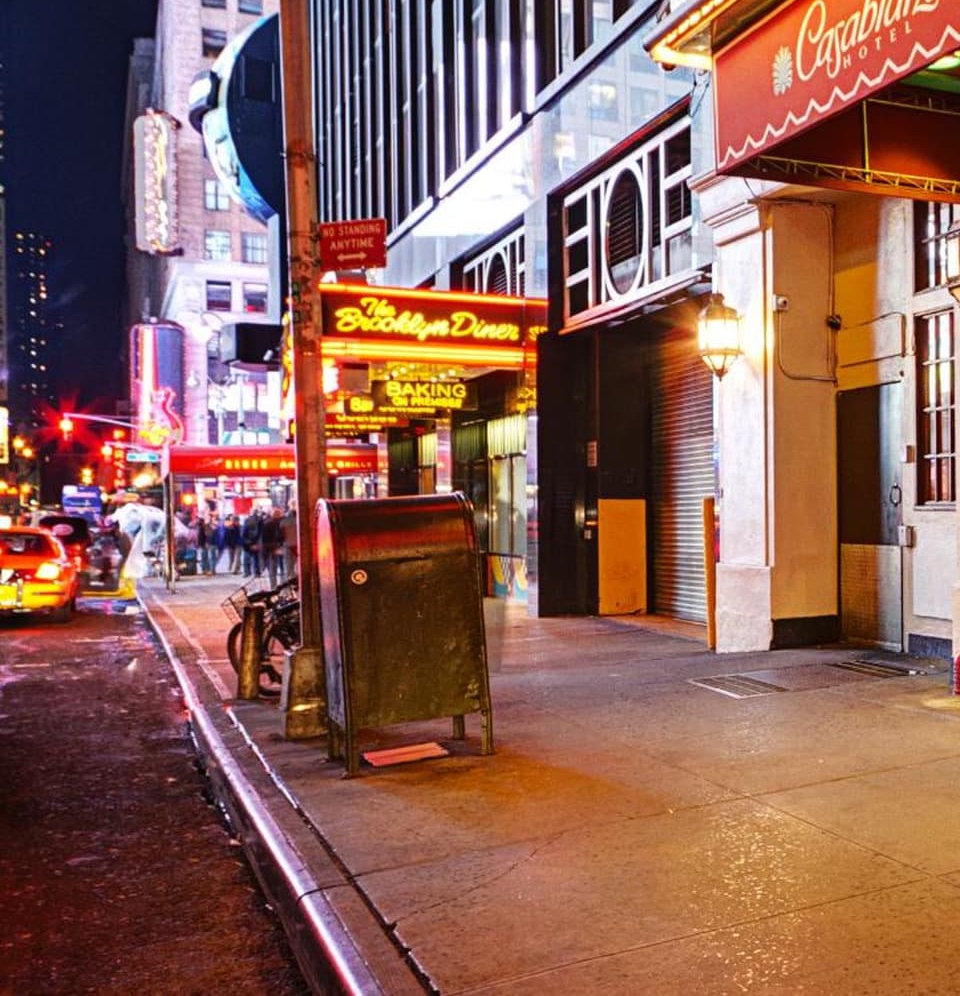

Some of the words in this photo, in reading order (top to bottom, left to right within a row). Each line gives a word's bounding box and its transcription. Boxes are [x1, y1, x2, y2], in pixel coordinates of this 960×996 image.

[842, 22, 913, 70] HOTEL
[323, 227, 335, 237] NO
[338, 223, 381, 236] STANDING
[329, 237, 375, 251] ANYTIME
[360, 297, 396, 317] The
[335, 307, 450, 341] Brooklyn
[450, 311, 520, 341] Diner
[386, 381, 467, 398] BAKING
